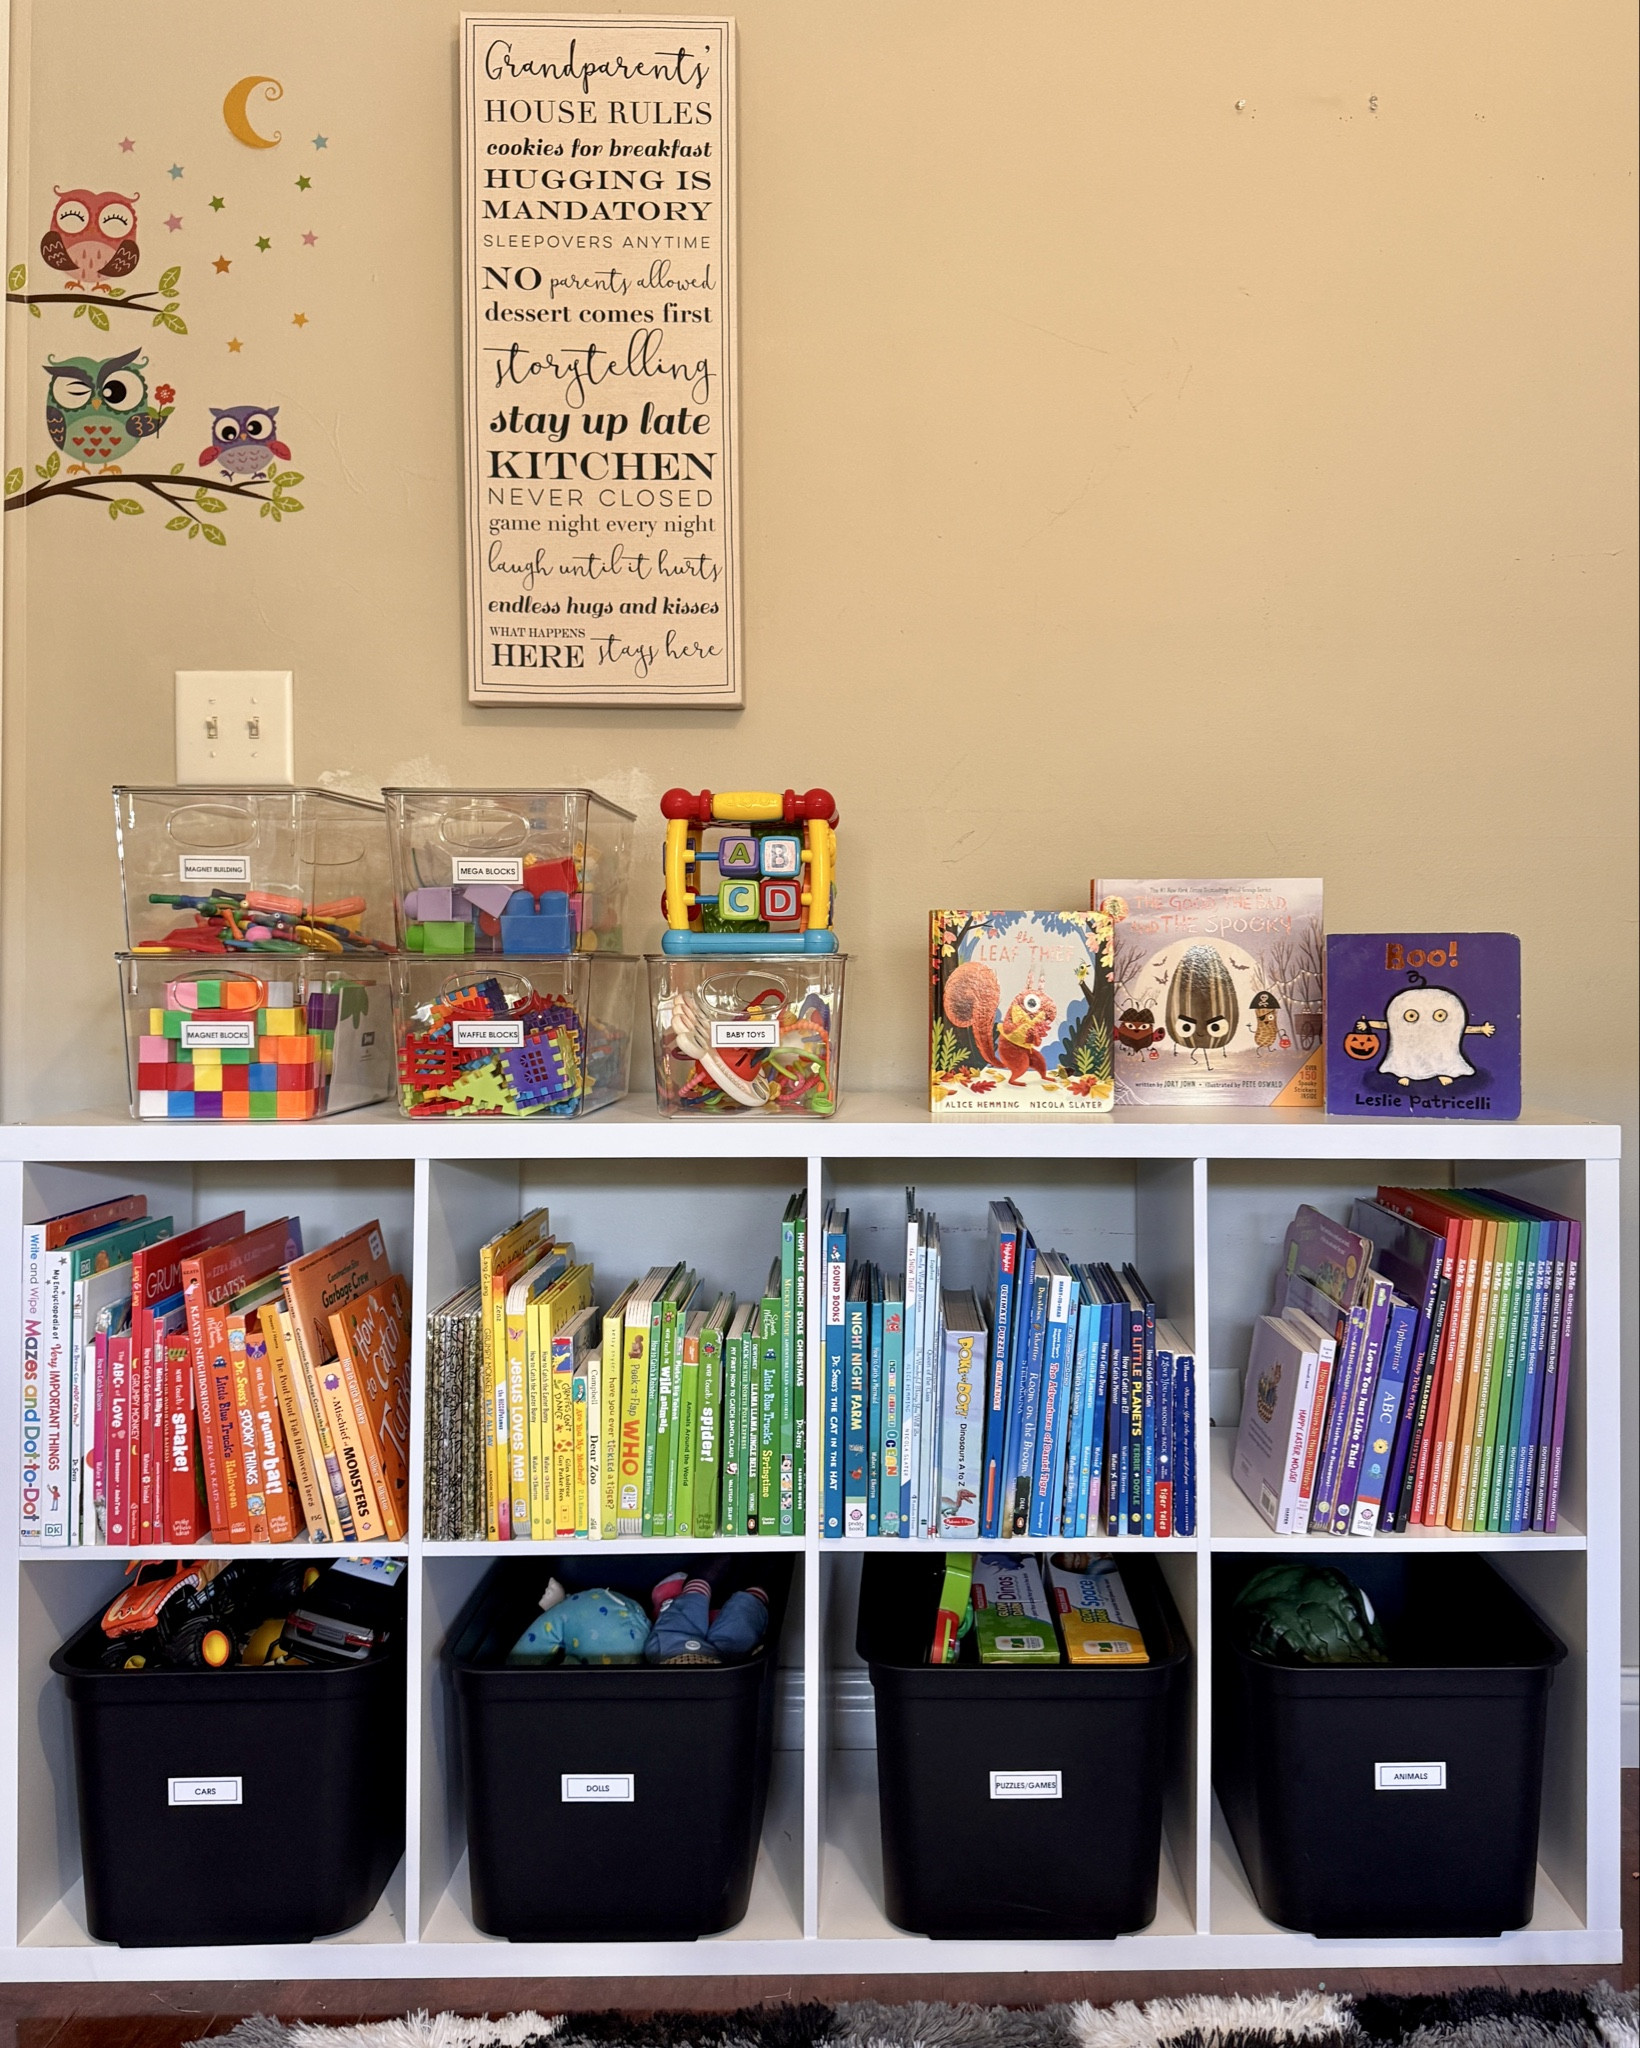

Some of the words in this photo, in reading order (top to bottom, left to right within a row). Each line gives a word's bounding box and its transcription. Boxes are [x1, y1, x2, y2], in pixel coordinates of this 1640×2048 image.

[485, 39, 710, 93] Grandparents'
[484, 99, 597, 124] HOUSE
[608, 101, 712, 125] RULES
[486, 138, 564, 156] cookies
[571, 138, 602, 158] for
[609, 138, 712, 158] breakfast
[484, 169, 664, 190] HUGGING
[676, 170, 711, 190] IS
[482, 200, 713, 221] MANDATORY
[483, 234, 613, 249] SLEEPOVERS
[622, 236, 710, 249] ANYTIME
[482, 266, 542, 290] NO
[550, 268, 631, 299] parents
[637, 259, 716, 290] allowed
[485, 301, 572, 323] dessert
[579, 305, 654, 323] comes
[662, 302, 712, 323] first
[483, 328, 717, 409] storytelling
[489, 406, 570, 443] stay
[582, 412, 629, 441] up
[640, 401, 711, 435] late
[486, 450, 717, 481] KITCHEN
[488, 487, 583, 506] NEVER
[599, 488, 713, 507] CLOSED
[489, 516, 541, 535] game
[547, 514, 600, 537] night
[606, 517, 658, 538] every
[664, 515, 716, 538] night
[488, 540, 554, 591] laugh
[559, 543, 623, 579] until
[621, 556, 652, 579] it
[658, 549, 723, 582] hurts
[488, 595, 561, 614] endless
[566, 597, 614, 618] hugs
[619, 597, 657, 615] and
[662, 597, 720, 615] kisses
[490, 626, 526, 638] WHAT
[528, 627, 586, 639] HAPPENS
[491, 643, 585, 669] HERE
[590, 633, 659, 679] stays
[666, 629, 723, 660] here
[729, 842, 751, 865] A
[771, 843, 791, 869] B
[185, 866, 212, 874] MAGNET
[213, 866, 243, 874] BUILDING
[460, 867, 484, 876] MEGA
[485, 868, 516, 876] BLOCKS
[729, 886, 750, 913] C
[770, 888, 791, 914] D
[980, 945, 1020, 962] LEAF
[1030, 945, 1074, 963] THIEF
[187, 1031, 218, 1039] MAGNET
[219, 1031, 249, 1039] BLOCKS
[459, 1031, 487, 1039] WAFFLE
[488, 1031, 519, 1039] BLOCKS
[726, 1030, 745, 1039] BABY
[746, 1030, 766, 1039] TOYS
[1180, 1080, 1196, 1088] JOHN
[1241, 1080, 1257, 1089] PETE
[1257, 1080, 1283, 1089] OSWALD
[1299, 1071, 1317, 1080] 150
[945, 1101, 973, 1109] ALICE
[977, 1101, 1020, 1109] HEMMING
[1030, 1101, 1065, 1109] NICOLA
[1068, 1101, 1103, 1109] SLATER
[1355, 1093, 1402, 1108] Leslie
[1409, 1095, 1491, 1110] Patricelli
[30, 1233, 40, 1260] Write
[797, 1232, 805, 1253] HOW
[29, 1263, 39, 1285] and
[797, 1256, 805, 1272] THE
[832, 1264, 841, 1293] SOUND
[29, 1287, 40, 1314] Wipe
[796, 1276, 805, 1308] GRINCH
[51, 1281, 60, 1332] Encyclopedia
[832, 1295, 841, 1323] BOOKS
[190, 1305, 201, 1345] KEATS'S
[796, 1310, 805, 1336] STOLE
[851, 1311, 863, 1350] NIGHT
[1132, 1324, 1143, 1332] 8
[1565, 1314, 1573, 1338] space
[24, 1319, 41, 1381] Mazes
[47, 1343, 63, 1370] Very
[831, 1355, 841, 1368] Dr.
[1132, 1336, 1143, 1377] LITTLE
[1365, 1348, 1377, 1374] Love
[796, 1339, 805, 1388] CHRISTMAS
[851, 1353, 863, 1391] NIGHT
[195, 1346, 211, 1424] NEIGHBORHOOD
[216, 1375, 229, 1401] Little
[590, 1369, 599, 1405] Campbell
[831, 1369, 841, 1393] Seuss's
[1360, 1374, 1372, 1396] You
[24, 1384, 41, 1423] and
[49, 1370, 61, 1430] IMPORTANT
[218, 1401, 231, 1422] Blue
[830, 1396, 838, 1413] THE
[851, 1394, 862, 1431] FARM
[1132, 1380, 1142, 1437] PLANETS
[1358, 1396, 1368, 1415] Just
[1379, 1391, 1396, 1425] ABC
[238, 1409, 254, 1448] SPOOKY
[258, 1410, 275, 1457] grumpy
[700, 1407, 714, 1463] spider!
[830, 1416, 838, 1436] CAT
[1353, 1417, 1365, 1442] Like
[48, 1431, 60, 1472] THINGS
[171, 1412, 189, 1473] snake!
[221, 1423, 234, 1458] Truck's
[590, 1434, 599, 1463] Dear
[622, 1419, 641, 1476] WHO
[830, 1437, 838, 1448] IN
[958, 1423, 968, 1462] Dinosaurs
[244, 1449, 258, 1486] THINGS
[830, 1450, 838, 1468] THE
[1348, 1443, 1360, 1469] This!
[23, 1426, 41, 1522] Dot-to-Dot
[225, 1460, 238, 1509] Halloween
[262, 1457, 283, 1495] bat!
[343, 1446, 370, 1518] MONSTERS
[590, 1464, 599, 1485] Zoo
[829, 1471, 838, 1491] HAT
[958, 1471, 966, 1480] to
[1159, 1487, 1168, 1511] tiger
[1550, 1490, 1558, 1522] ADVANTAGE
[1159, 1512, 1167, 1531] tales
[998, 1576, 1013, 1600] Dinos
[1081, 1580, 1099, 1608] Space
[995, 1781, 1057, 1789] PUZZLES/GAMES
